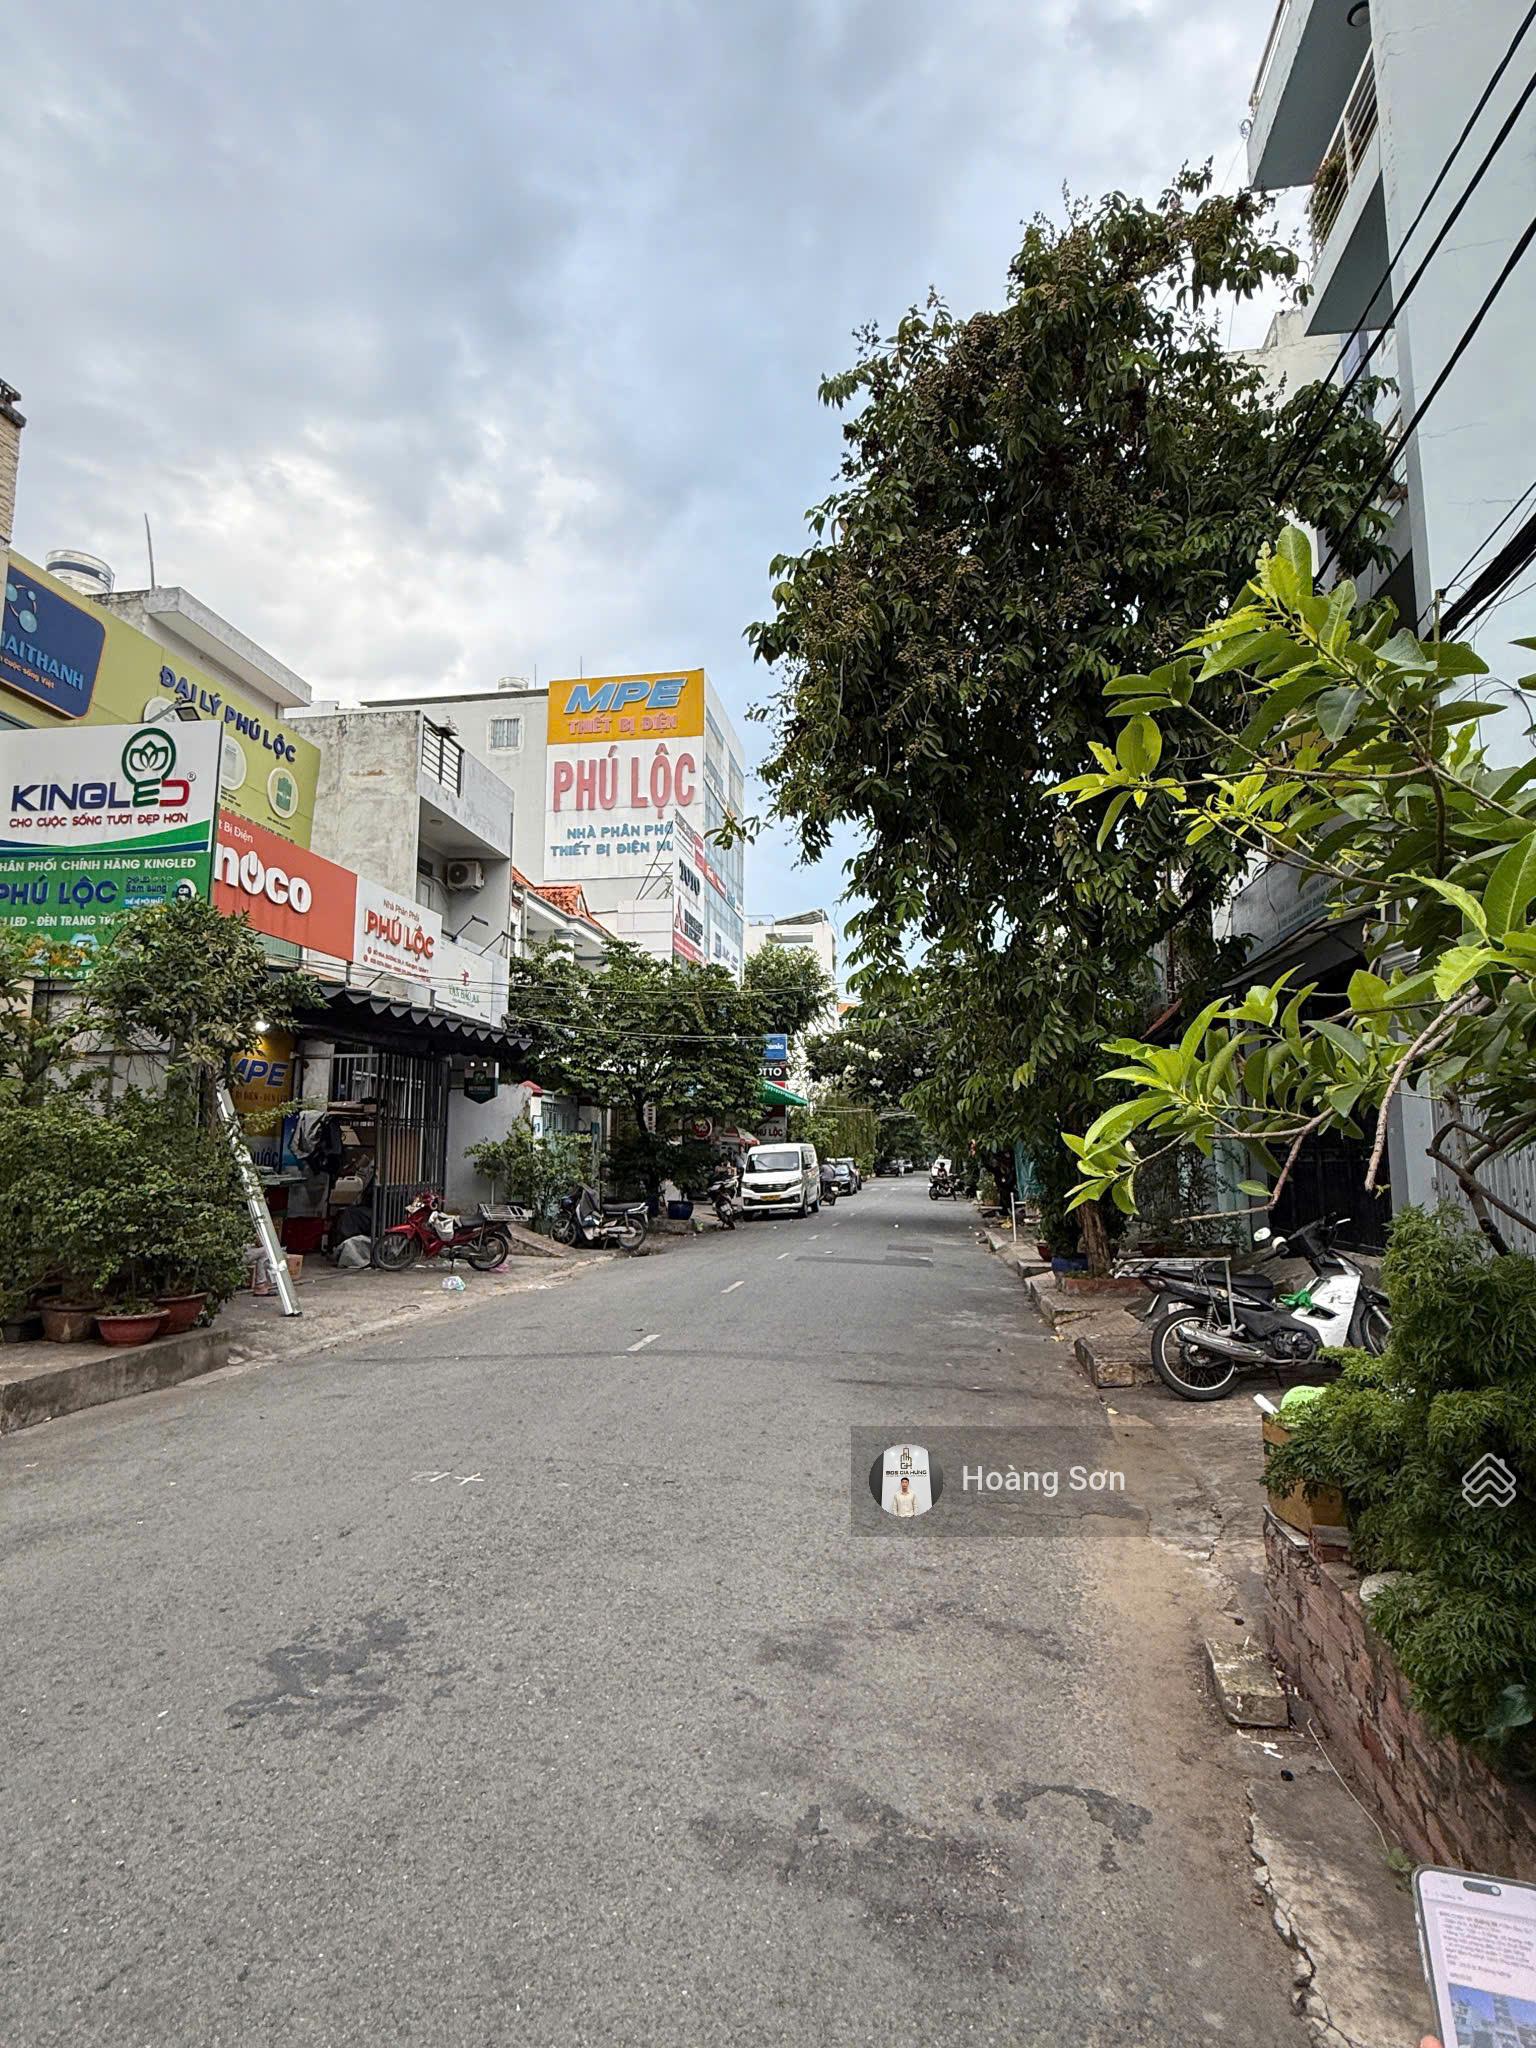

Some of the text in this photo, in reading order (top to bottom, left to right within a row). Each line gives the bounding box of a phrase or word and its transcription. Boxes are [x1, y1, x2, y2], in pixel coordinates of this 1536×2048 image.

[564, 678, 687, 714] MPE
[199, 689, 223, 716] LÝ
[224, 705, 261, 740] PHÚ
[263, 729, 296, 763] LỘC
[567, 712, 677, 736] THIẾT BỊ ĐIỆN
[552, 743, 696, 820] PHÚ LỘC
[11, 777, 190, 812] KINGLED
[9, 812, 189, 829] CHO CUỘC SỐNG TƯƠI ĐẸP HƠN
[566, 824, 597, 840] NHÀ
[600, 823, 640, 839] PHÂN
[223, 821, 233, 835] Bị
[234, 826, 253, 844] Điện
[550, 840, 591, 857] THIẾT
[596, 843, 611, 857] BỊ
[616, 839, 650, 856] ĐIỆN
[28, 857, 57, 871] PHỐI
[61, 858, 100, 871] CHÍNH
[144, 858, 197, 869] KINGLED
[59, 873, 119, 909] LỘC
[384, 898, 394, 911] Nhà
[395, 904, 408, 917] Phân
[10, 916, 28, 927] LED
[36, 912, 57, 926] ĐÈN
[60, 915, 96, 926] TRANG
[364, 907, 402, 946] PHÚ
[403, 925, 435, 962] LỘC
